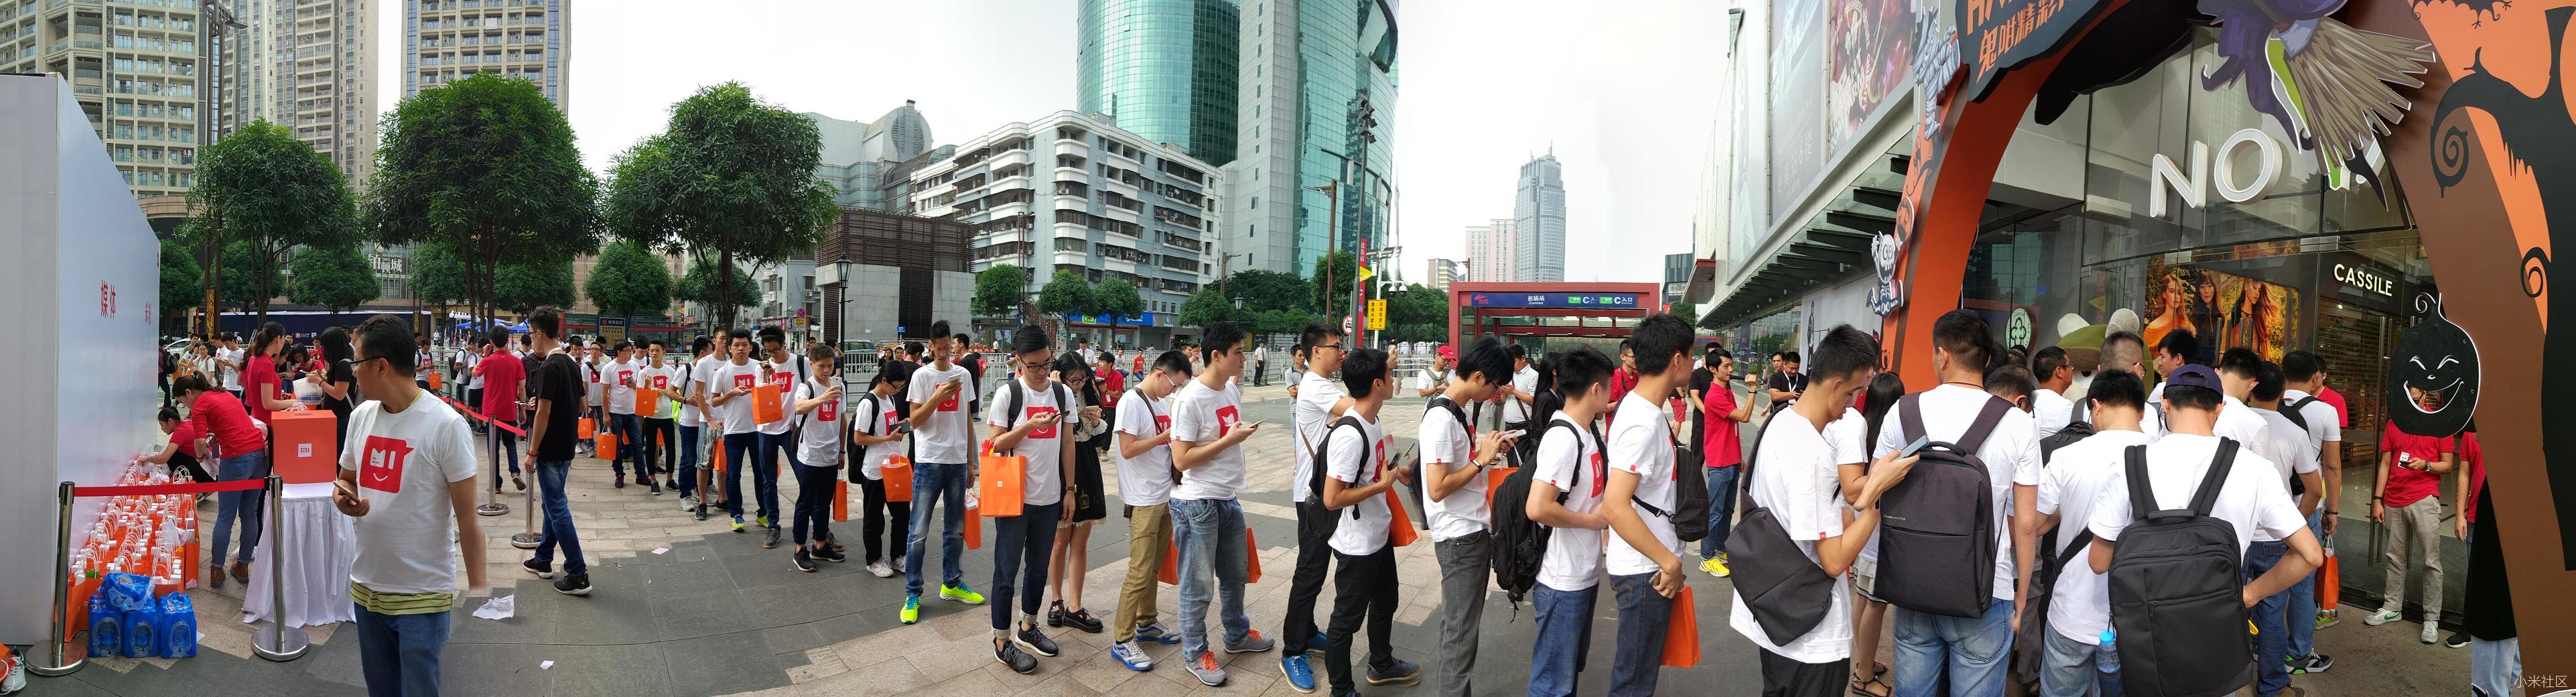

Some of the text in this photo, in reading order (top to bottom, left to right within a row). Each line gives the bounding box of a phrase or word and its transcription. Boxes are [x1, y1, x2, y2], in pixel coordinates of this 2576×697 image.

[2334, 263, 2392, 297] CASSILE
[100, 279, 116, 320] 媒体
[738, 379, 750, 387] MI
[823, 403, 832, 412] MI
[370, 448, 396, 469] MI
